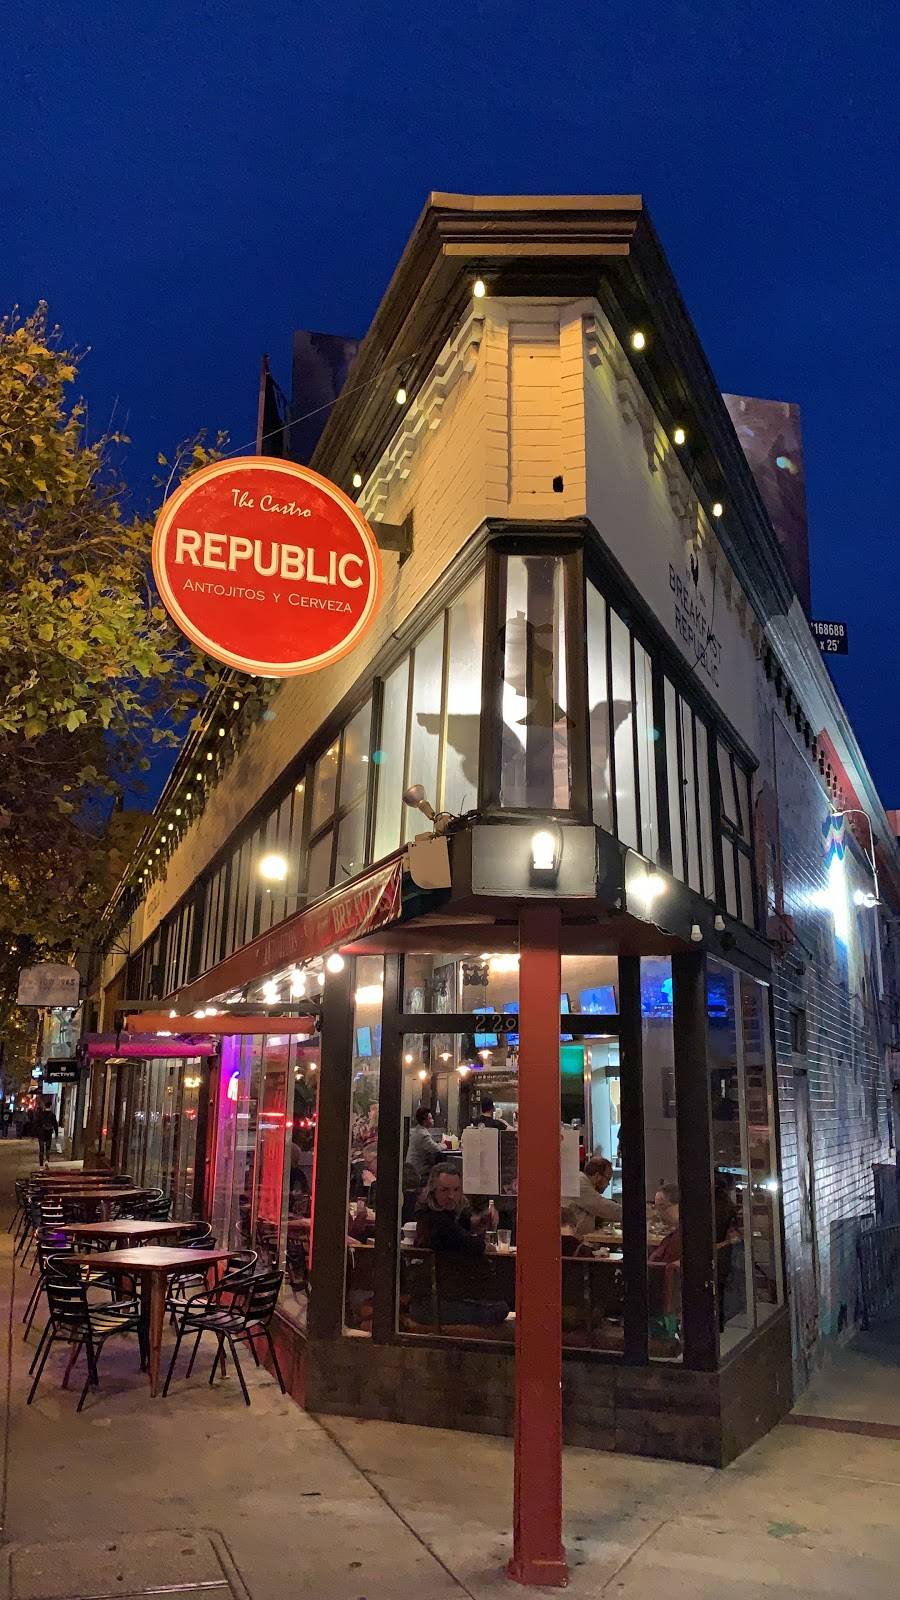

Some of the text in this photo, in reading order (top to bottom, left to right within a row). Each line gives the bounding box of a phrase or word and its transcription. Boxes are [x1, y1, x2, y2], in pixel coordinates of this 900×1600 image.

[231, 488, 312, 518] The Castro
[174, 528, 364, 589] REPUBLIC
[182, 578, 353, 613] ANTOJITOS Y CERVEZA
